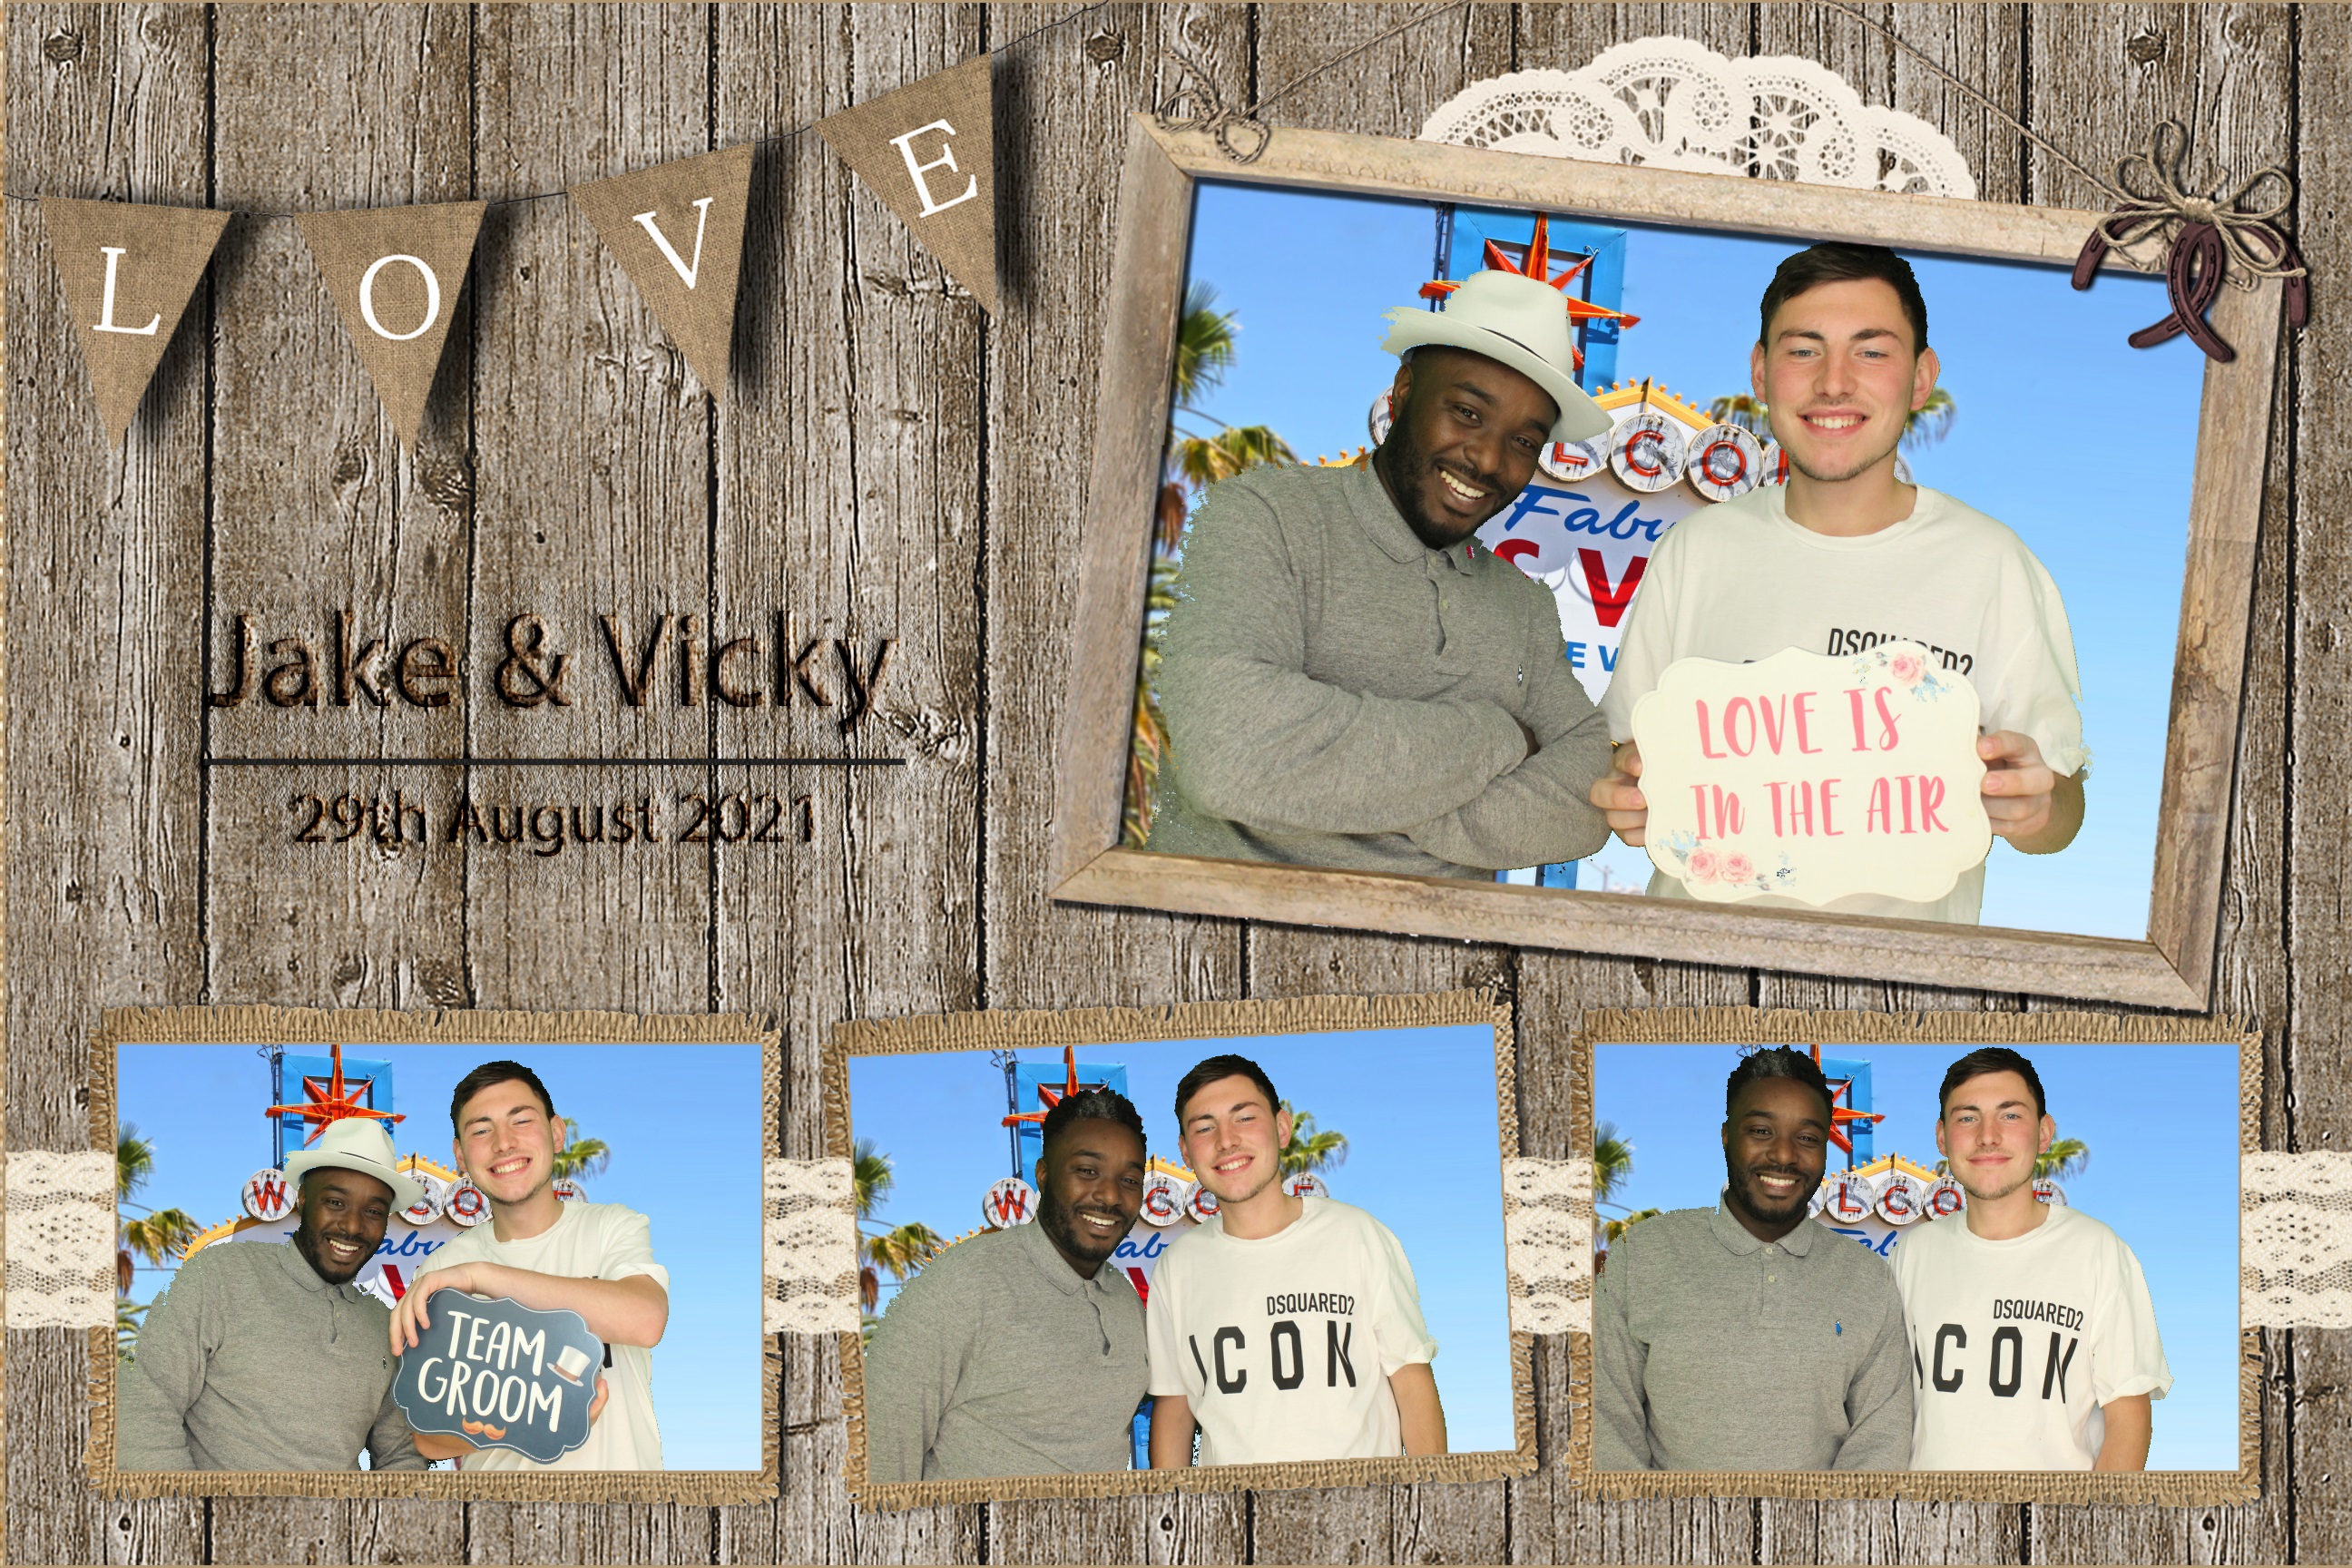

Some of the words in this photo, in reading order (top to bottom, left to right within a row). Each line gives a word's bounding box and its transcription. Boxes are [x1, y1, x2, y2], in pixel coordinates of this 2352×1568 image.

[1696, 691, 1823, 760] LOVE
[1843, 685, 1902, 752] IS
[1763, 778, 1845, 838] THE
[1867, 775, 1951, 835] AIR
[1267, 1292, 1356, 1316] DSQUARED2
[1993, 1298, 2084, 1332] DSQUARED2
[447, 1310, 545, 1377] TEAM
[1189, 1320, 1357, 1396] ICON
[417, 1357, 563, 1433] GROOM
